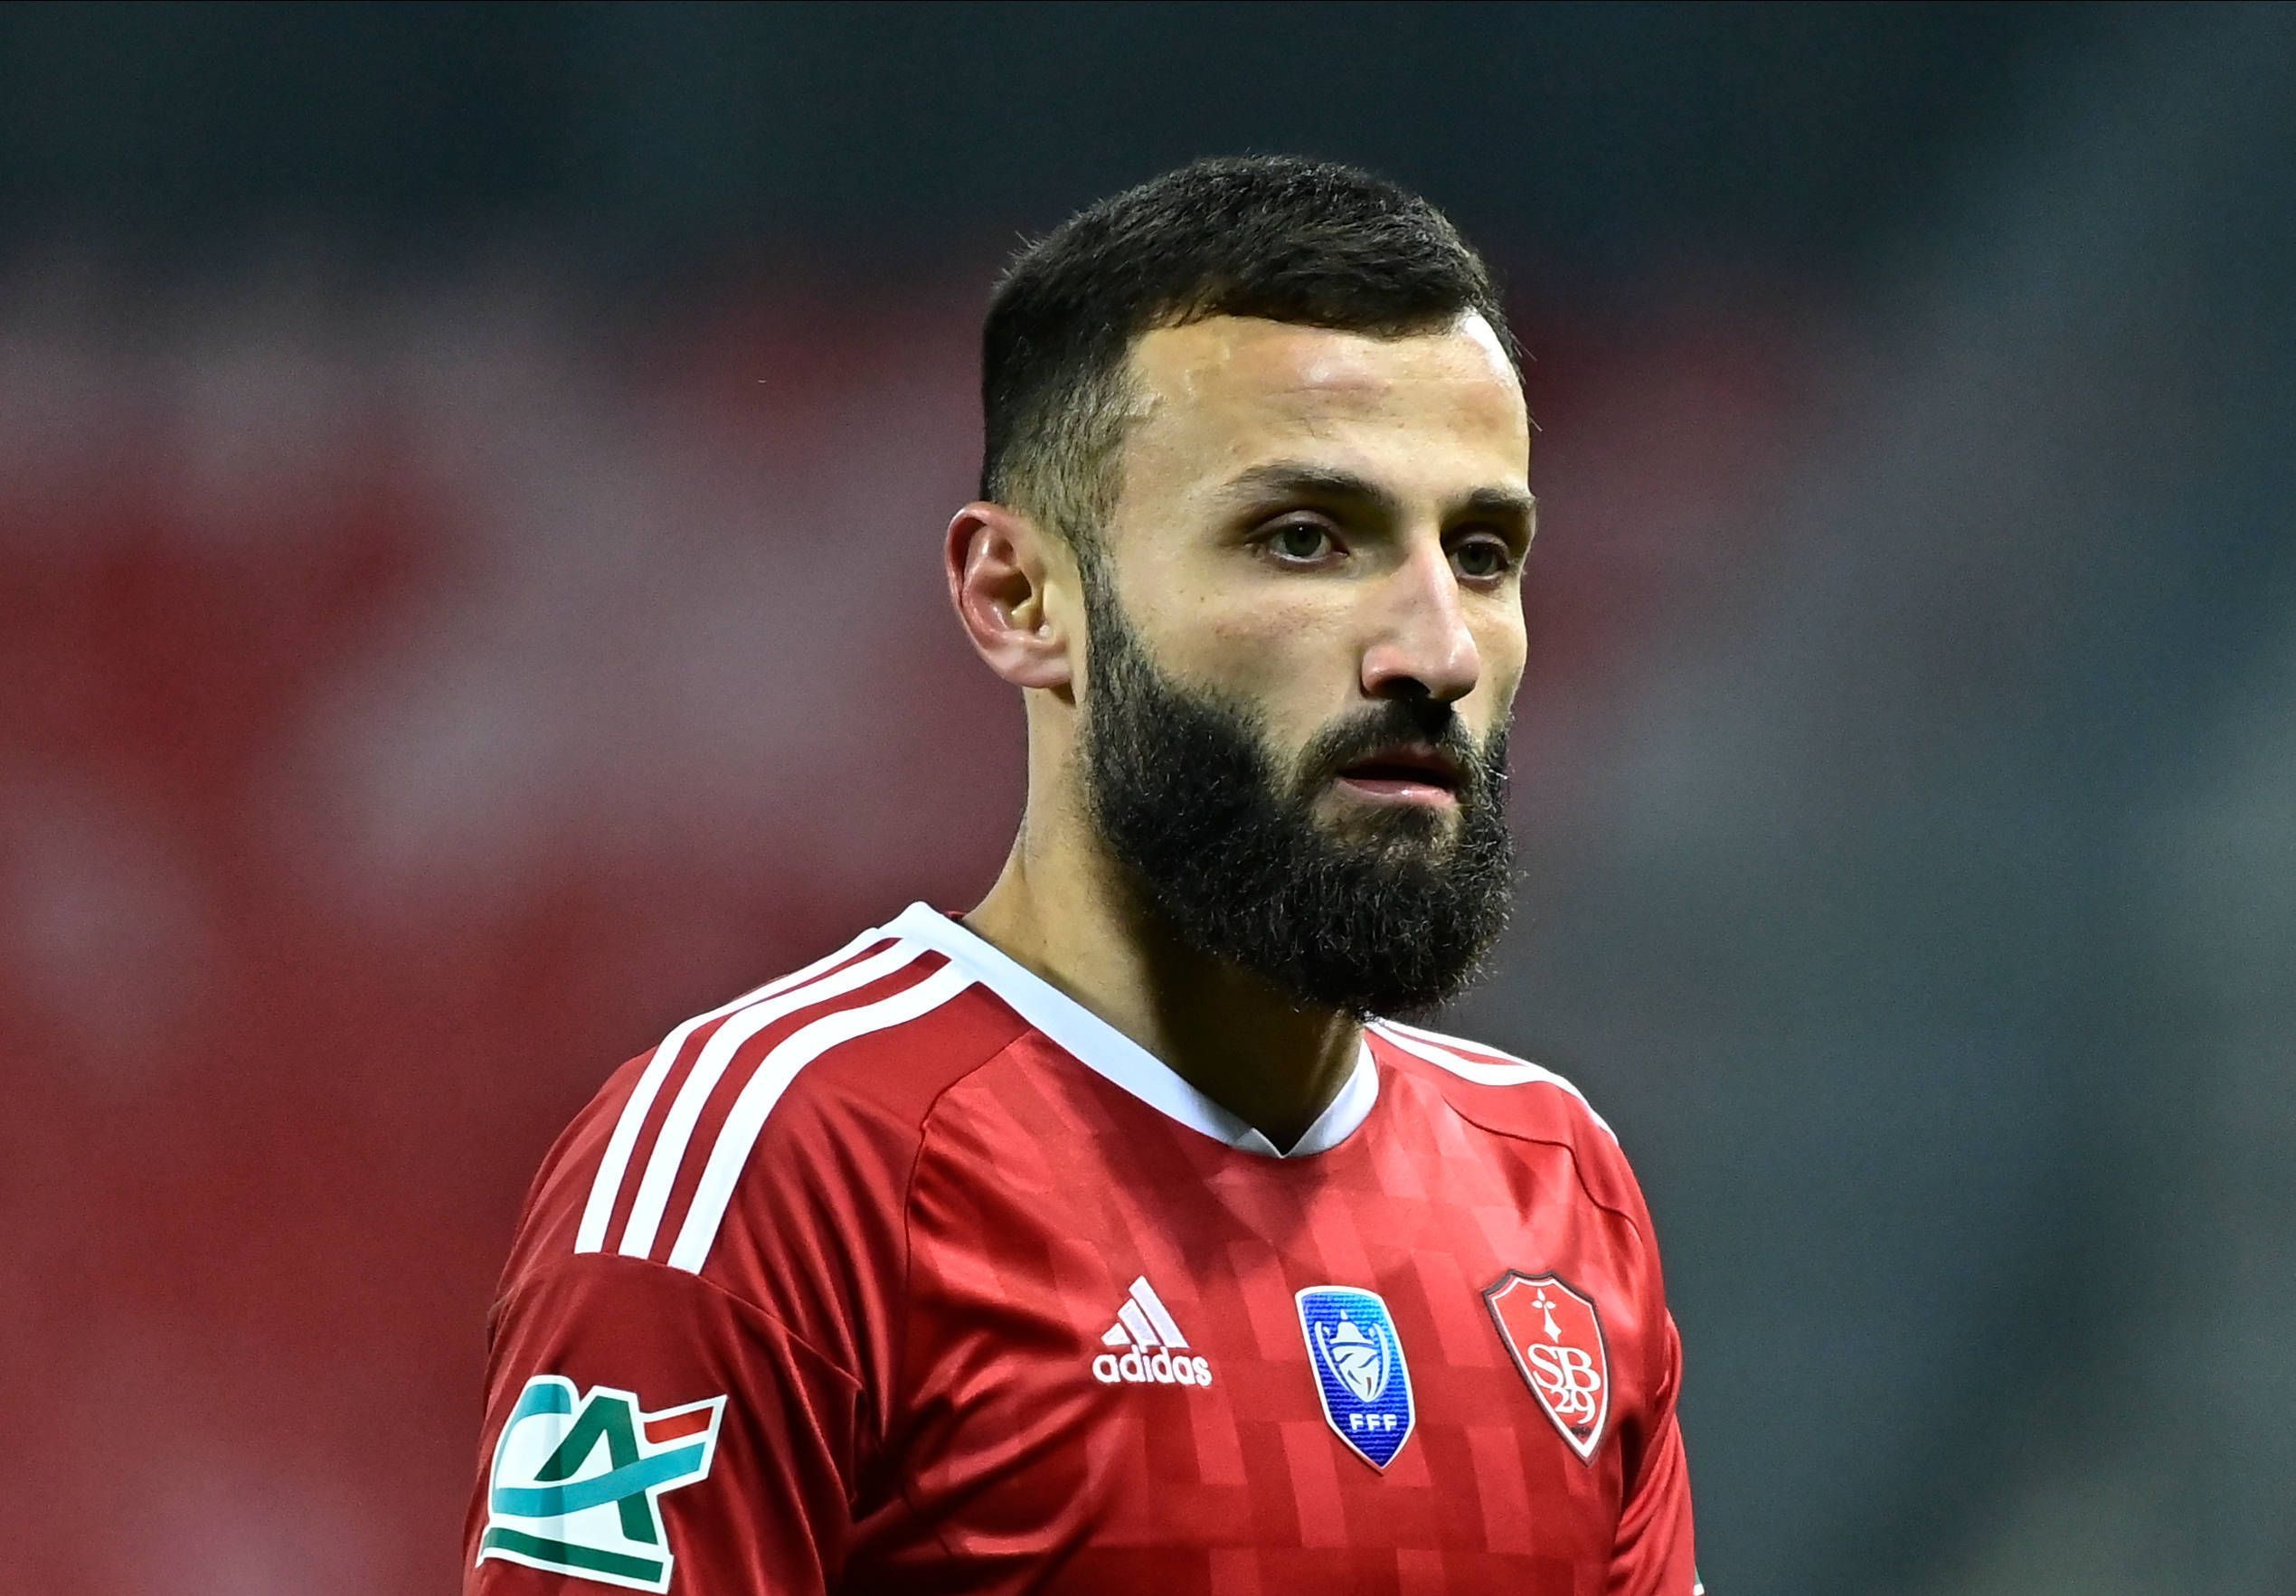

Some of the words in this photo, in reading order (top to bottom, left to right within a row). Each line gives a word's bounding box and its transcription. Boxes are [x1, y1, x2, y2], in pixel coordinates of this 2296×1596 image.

[1092, 1345, 1213, 1385] adidas
[1528, 1344, 1601, 1393] SB
[1349, 1413, 1397, 1431] FFF
[1551, 1388, 1595, 1424] 29
